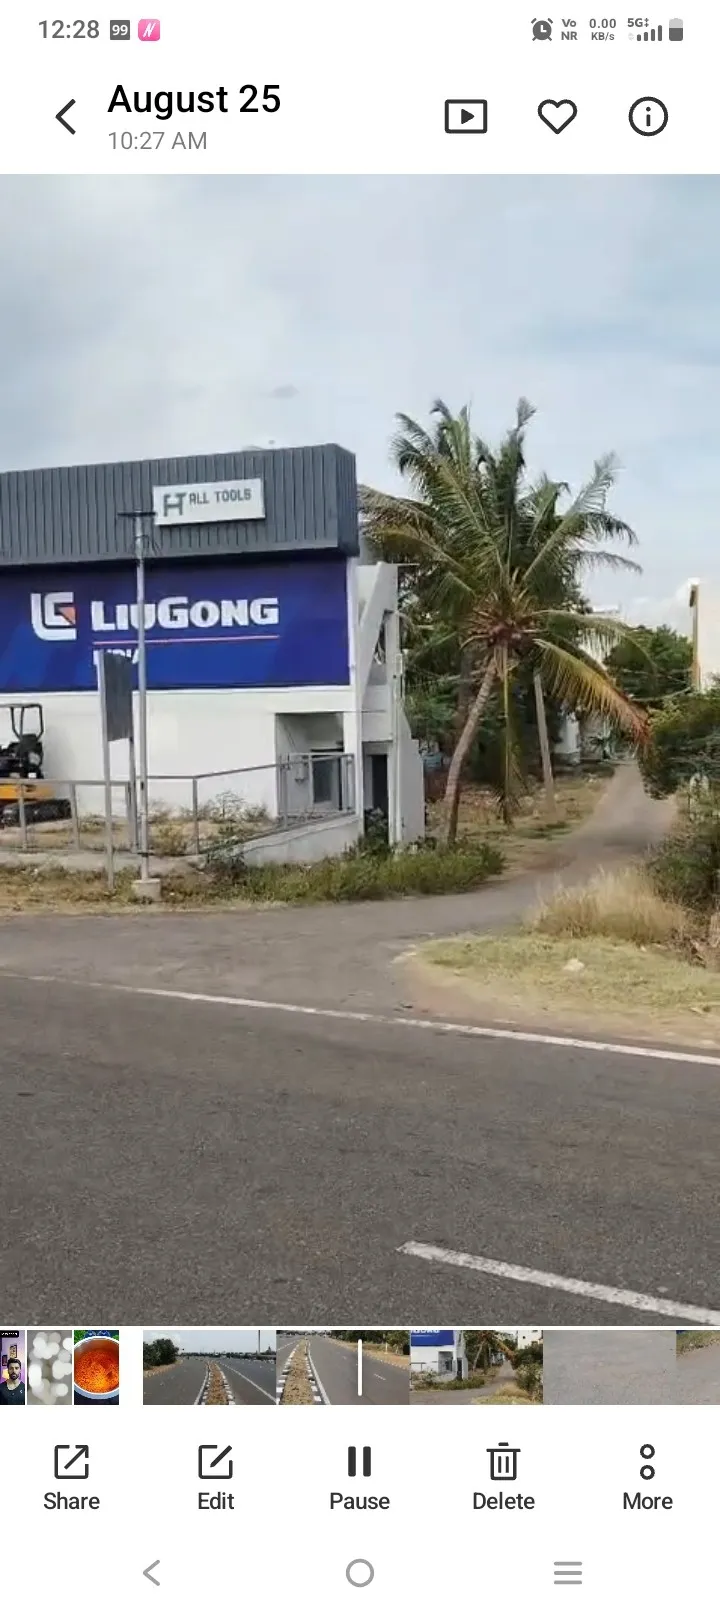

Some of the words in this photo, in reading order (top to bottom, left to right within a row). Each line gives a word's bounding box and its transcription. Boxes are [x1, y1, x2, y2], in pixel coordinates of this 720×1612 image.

[38, 19, 100, 39] 12:28
[112, 24, 129, 36] 99
[561, 18, 577, 28] Vo
[589, 18, 617, 29] 0.00
[561, 30, 578, 41] NR
[591, 31, 615, 41] KB/s
[107, 84, 229, 121] August
[238, 83, 281, 114] 25
[108, 131, 165, 150] 10:27
[171, 131, 208, 150] AM
[189, 492, 210, 505] ALL
[214, 488, 252, 503] TOOLS
[43, 1491, 101, 1510] Share
[197, 1491, 235, 1510] Edit
[330, 1492, 391, 1510] Pause
[473, 1491, 536, 1510] Delete
[623, 1491, 674, 1510] More
